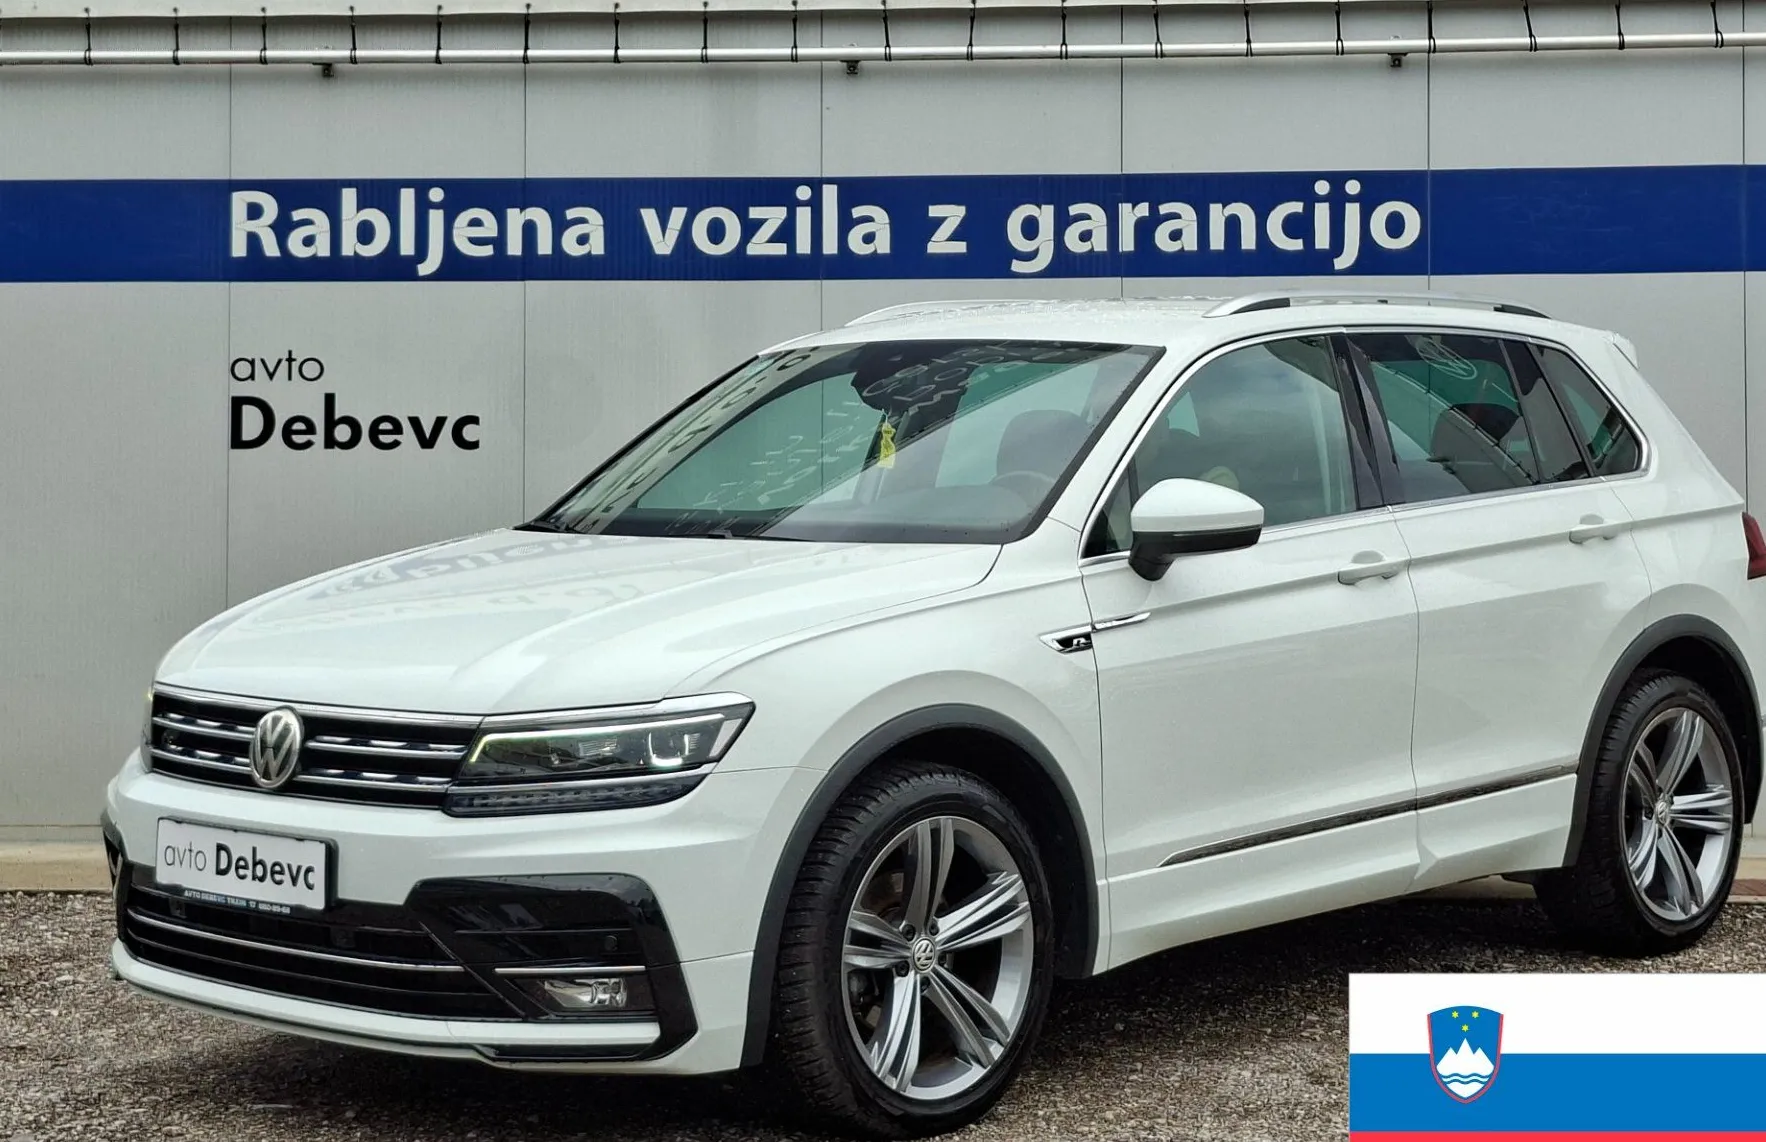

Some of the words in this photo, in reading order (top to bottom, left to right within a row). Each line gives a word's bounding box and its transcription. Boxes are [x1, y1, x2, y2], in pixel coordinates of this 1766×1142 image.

[231, 187, 605, 276] Rabljena
[639, 184, 891, 256] vozila
[926, 204, 967, 254] z
[1006, 181, 1421, 274] garancijo
[230, 349, 325, 382] avto
[230, 392, 481, 451] Debevc
[163, 841, 207, 872] avto
[214, 842, 316, 891] Debevc
